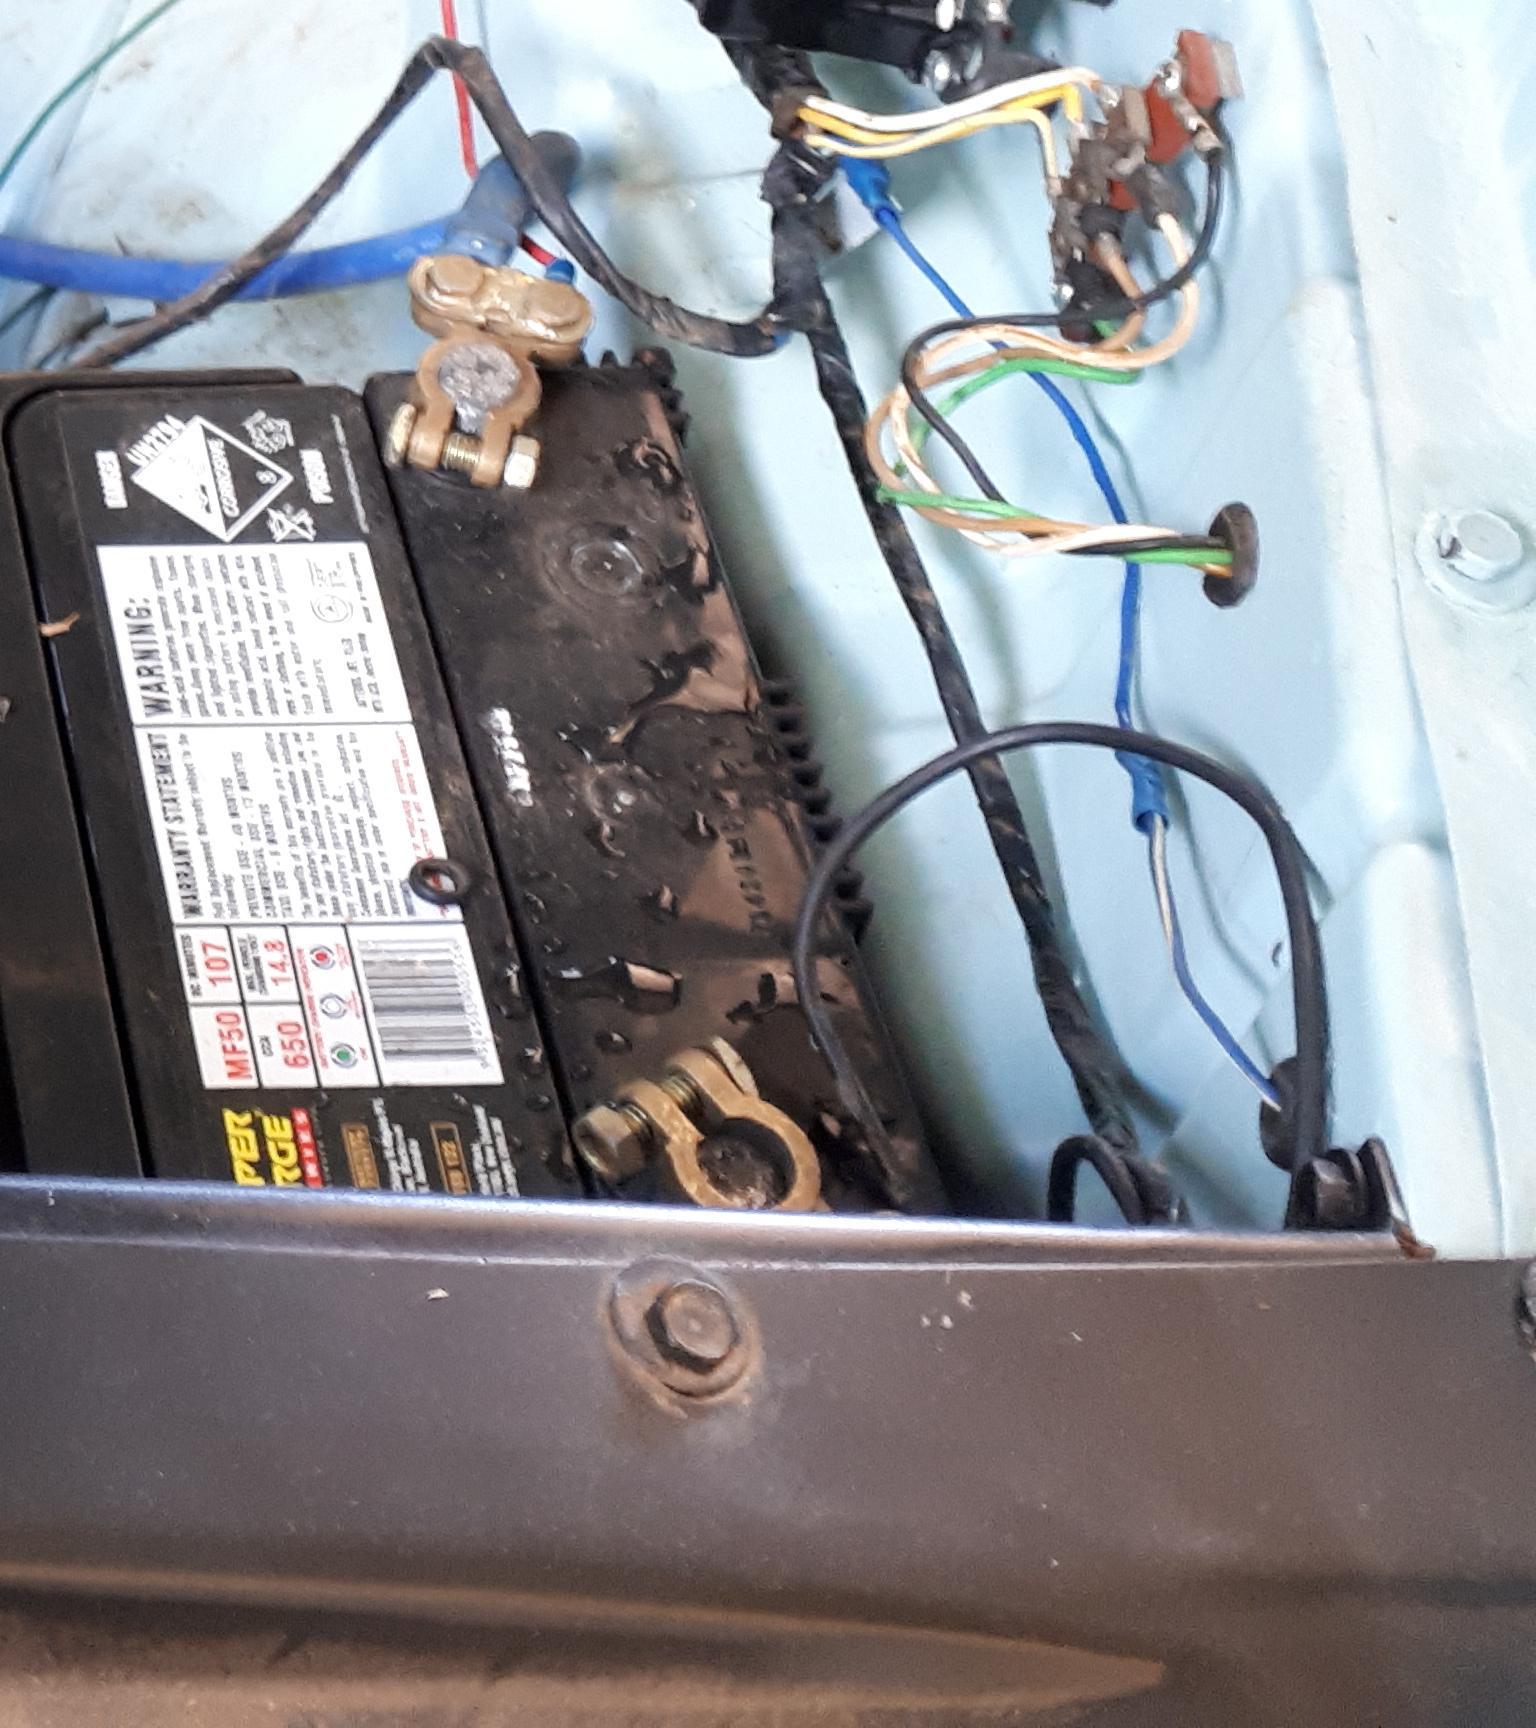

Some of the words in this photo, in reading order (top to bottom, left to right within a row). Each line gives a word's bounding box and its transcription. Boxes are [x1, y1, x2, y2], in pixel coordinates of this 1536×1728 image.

[125, 414, 185, 466] UN2794
[207, 438, 239, 517] CORROSIVE
[256, 472, 277, 484] 8
[299, 449, 333, 503] POISON
[123, 597, 172, 718] WARNING:
[147, 733, 185, 824] STATEMENT
[166, 828, 204, 919] WARRANTY
[200, 941, 234, 986] 107
[262, 940, 292, 985] 14.8
[214, 1012, 253, 1079] MF50
[258, 1035, 273, 1056] CCA
[276, 1021, 310, 1068] 650
[222, 1109, 265, 1186] PER
[262, 1115, 302, 1186] RGE
